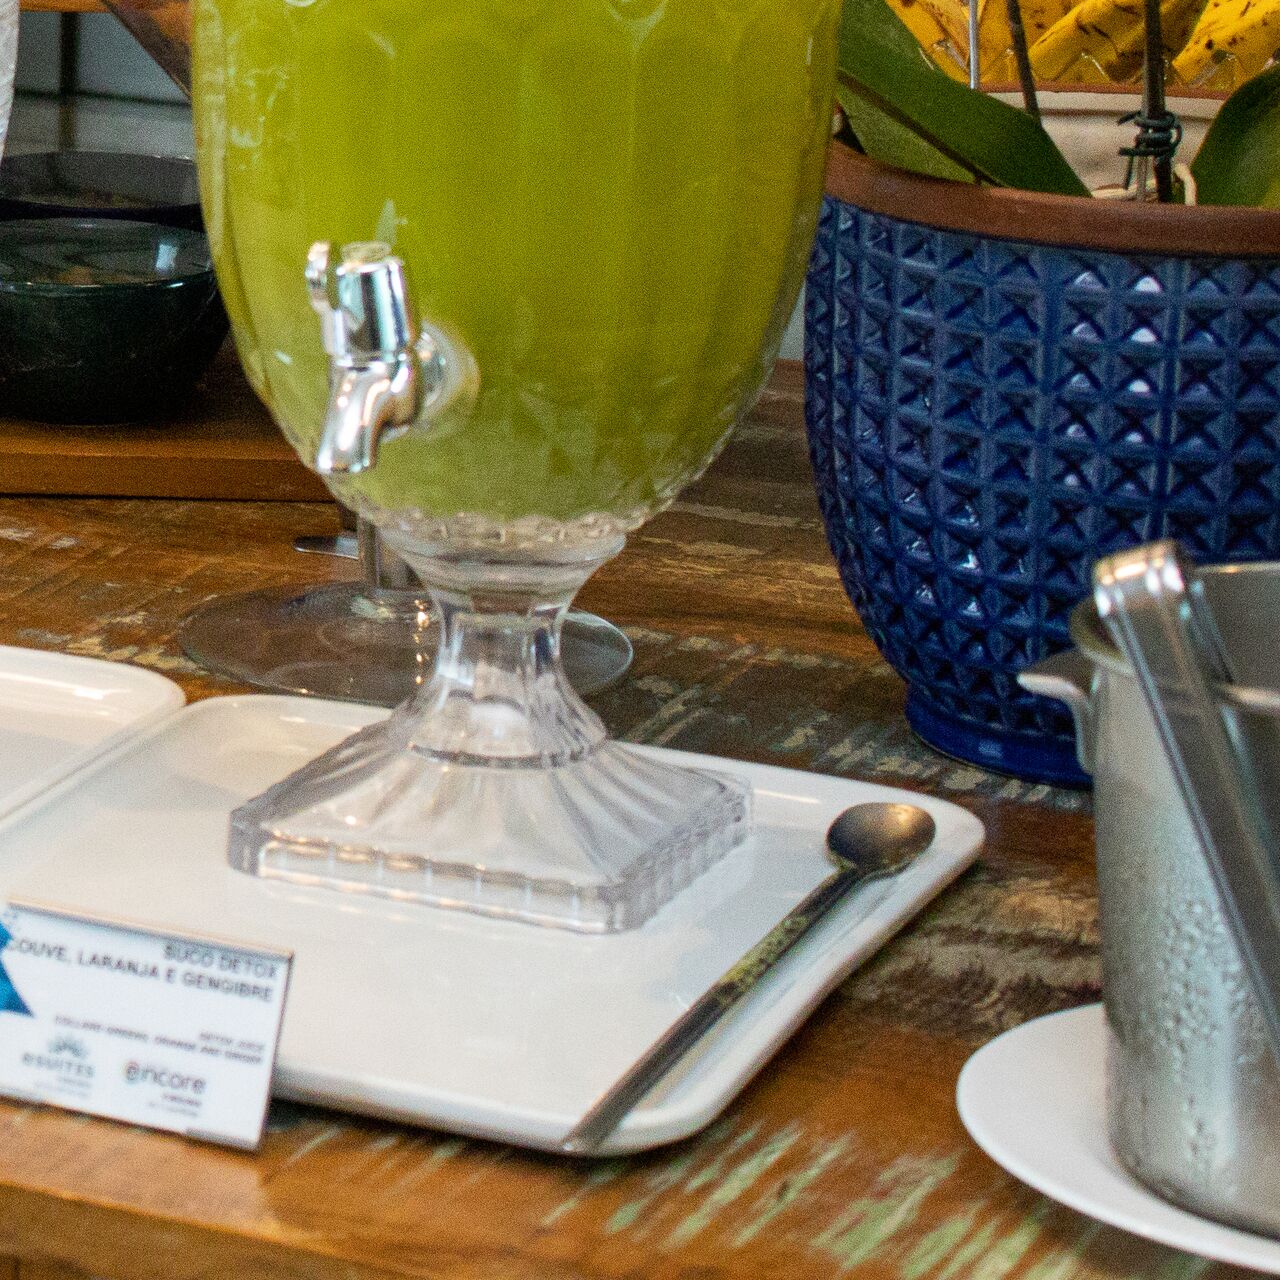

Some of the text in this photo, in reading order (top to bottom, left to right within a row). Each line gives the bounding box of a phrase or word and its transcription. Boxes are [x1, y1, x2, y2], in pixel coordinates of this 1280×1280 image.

[164, 942, 214, 970] SUCO
[77, 950, 159, 979] LARANJA
[165, 967, 178, 984] E
[182, 970, 274, 1003] GENGIBRE
[125, 1060, 207, 1095] encore
